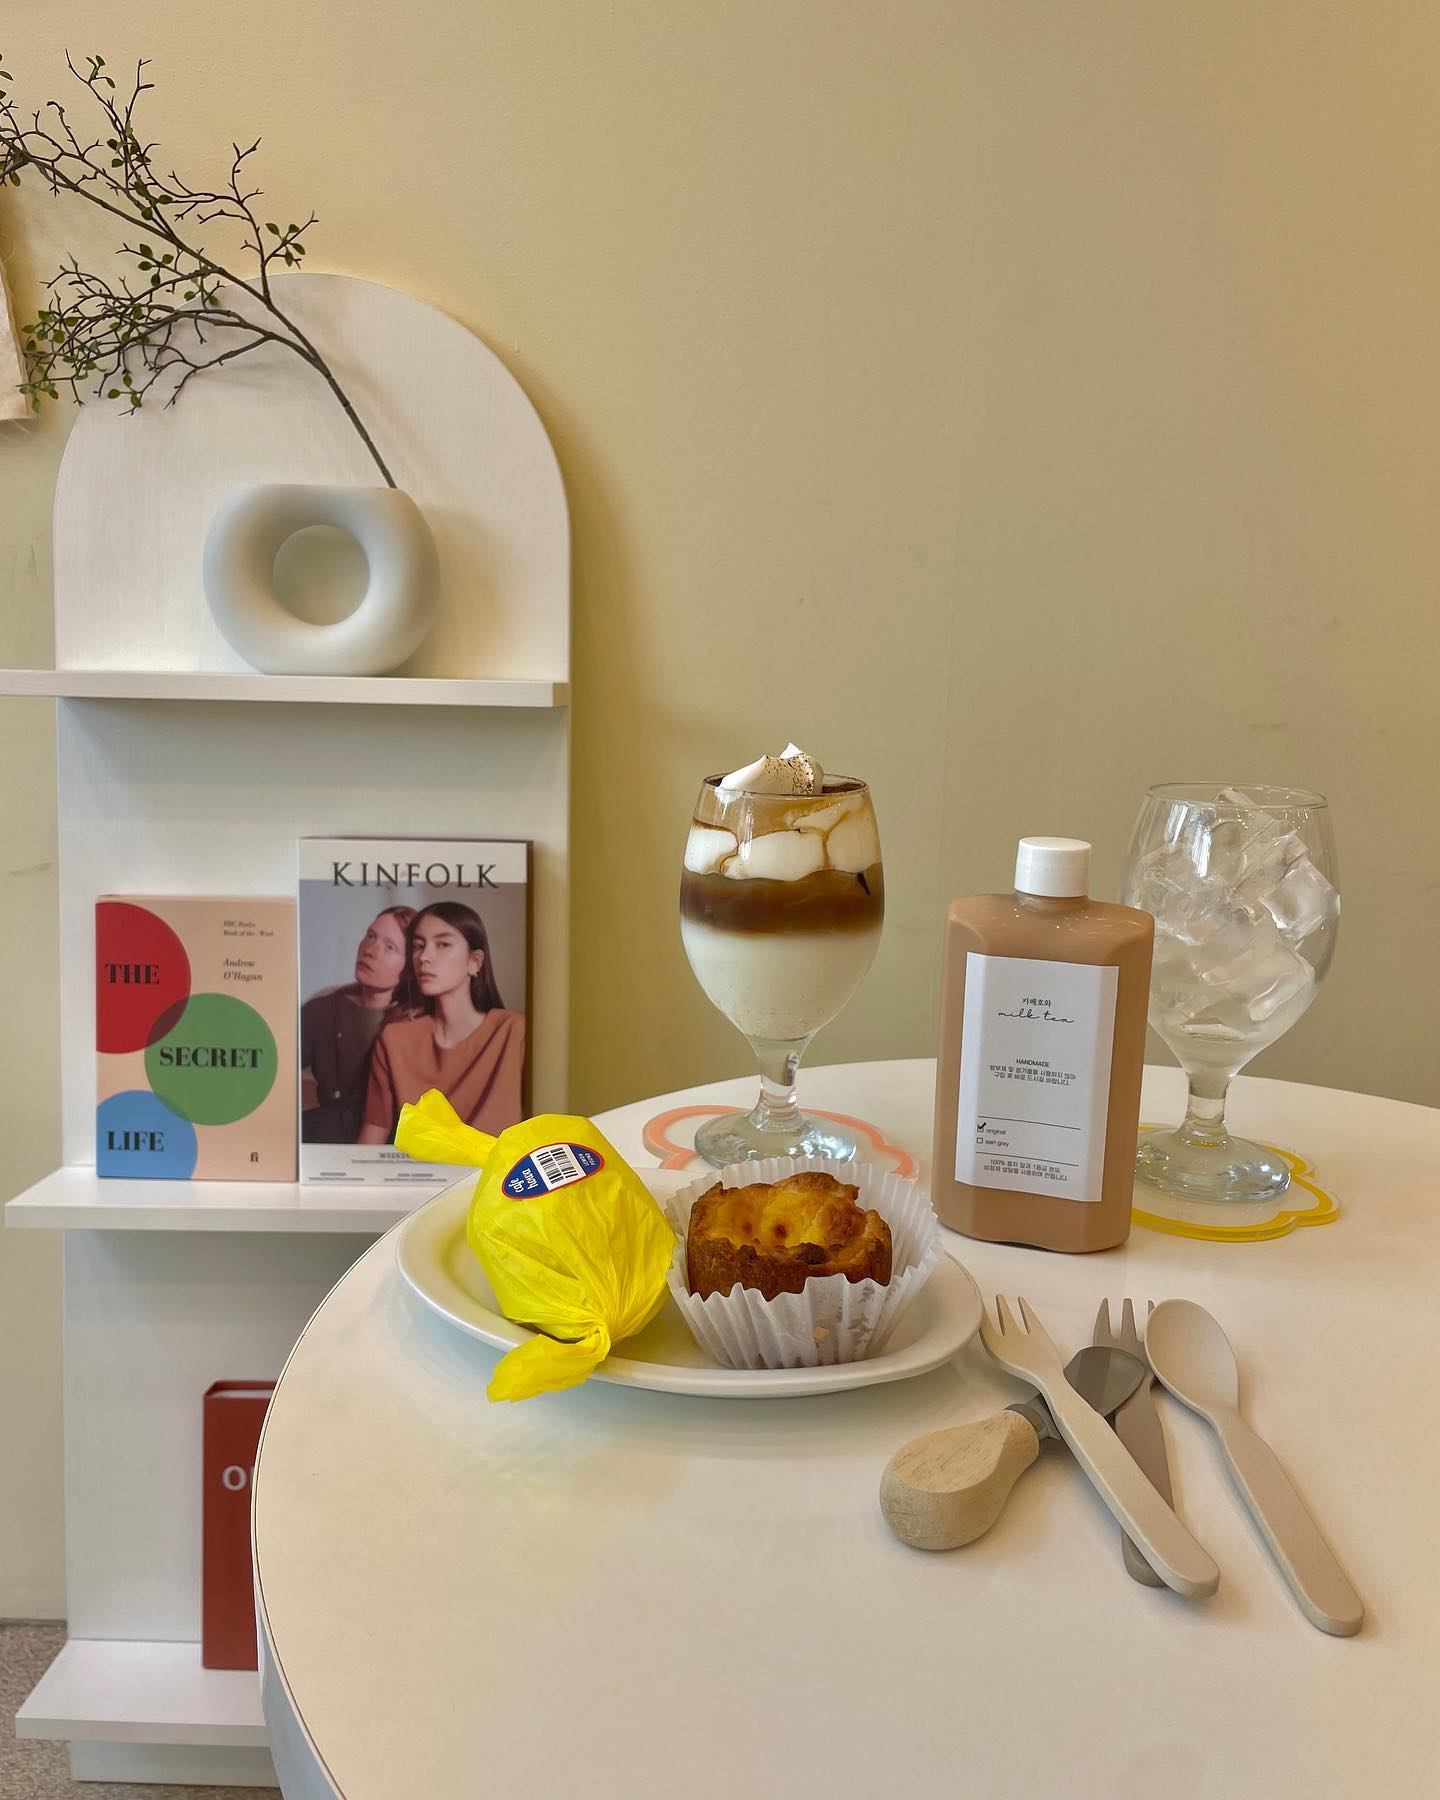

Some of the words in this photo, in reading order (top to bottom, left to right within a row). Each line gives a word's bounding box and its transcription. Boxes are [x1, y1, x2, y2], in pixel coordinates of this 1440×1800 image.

[332, 862, 499, 889] KINFOLK
[223, 957, 256, 967] Andrew
[104, 963, 160, 985] THE
[223, 970, 263, 982] O'Hagan
[1022, 997, 1052, 1008] 카페호와
[998, 1008, 1039, 1019] milk
[1043, 1010, 1075, 1023] tea
[159, 1046, 264, 1069] SECRET
[1016, 1058, 1050, 1067] HANDMADE
[1040, 1069, 1063, 1078] 사용하지
[986, 1127, 1006, 1135] original
[106, 1131, 165, 1153] LIFE
[508, 1178, 525, 1193] cafe
[522, 1168, 539, 1190] howa
